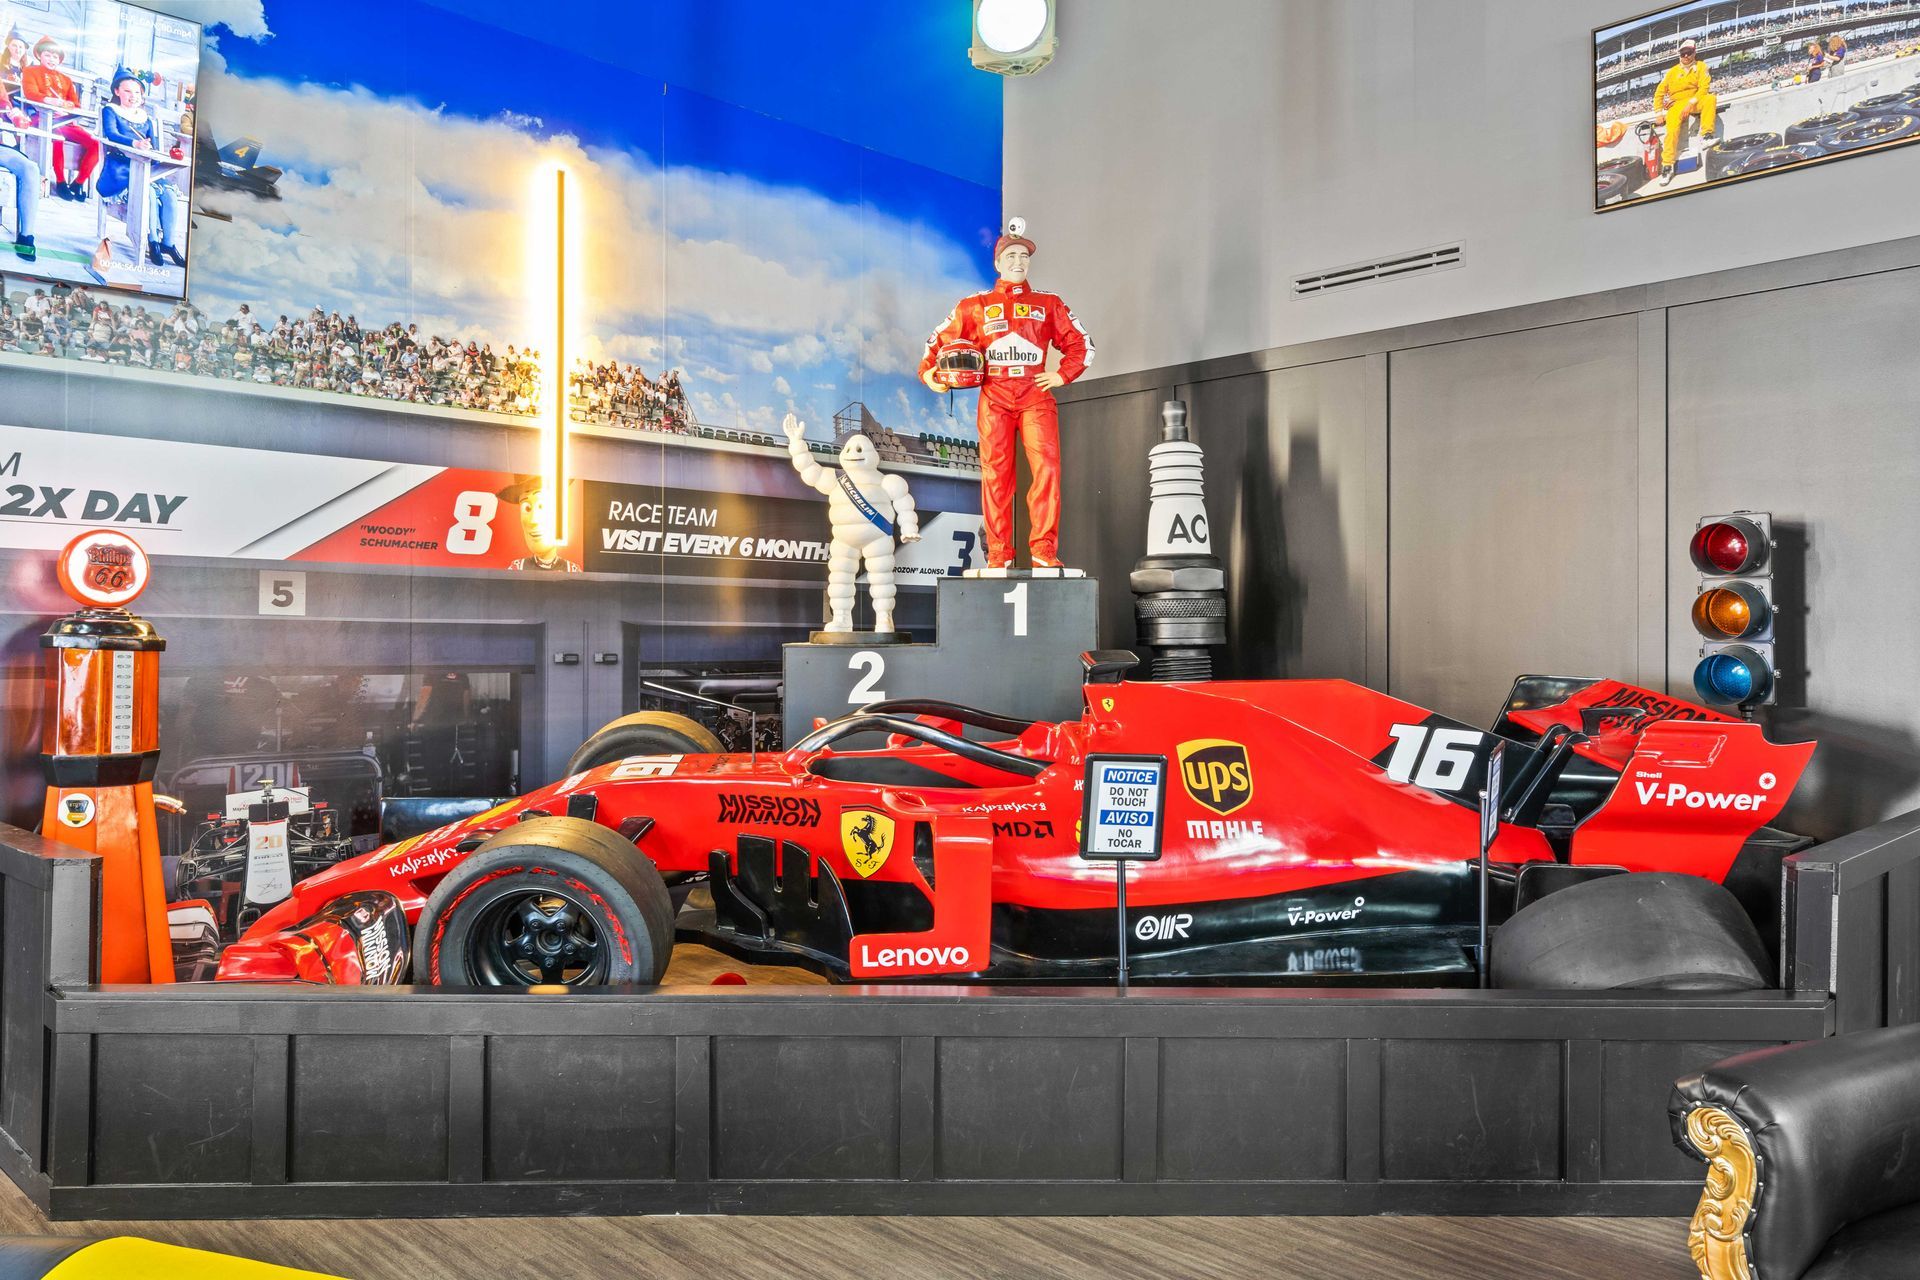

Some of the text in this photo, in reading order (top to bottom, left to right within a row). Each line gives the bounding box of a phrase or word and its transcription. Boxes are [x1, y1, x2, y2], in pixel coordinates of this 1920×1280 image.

[235, 146, 249, 158] 4
[988, 346, 1038, 362] Marlboro
[81, 489, 188, 525] DAY
[845, 481, 875, 516] MICHELIN
[446, 490, 499, 555] 8
[608, 501, 718, 528] RACE TEAM
[360, 524, 416, 536] "WOODY"
[1167, 513, 1207, 544] AC
[360, 538, 438, 550] SCHUMACHER
[602, 528, 832, 561] VISIT EVERY 6 MONTH
[947, 530, 975, 576] 3
[95, 567, 127, 588] 66
[919, 567, 945, 575] ALONSO
[271, 580, 294, 608] 5
[1003, 583, 1027, 636] 1
[848, 651, 885, 704] 2
[1389, 723, 1484, 791] 16
[1107, 770, 1154, 783] NOTICE
[1185, 761, 1248, 802] ups
[1635, 771, 1662, 779] Shell
[1109, 787, 1149, 797] DO NOT
[1111, 797, 1146, 807] TOUCH
[1635, 781, 1767, 811] V-Power
[718, 793, 822, 814] MISSION
[962, 802, 1038, 813] KASPERSKY
[717, 809, 821, 828] WINNOW
[1105, 811, 1149, 824] AVISO
[1118, 829, 1132, 838] NO
[1186, 820, 1263, 838] MAHLE
[1107, 839, 1142, 848] TOCAR
[389, 848, 459, 877] KASPERSKY
[1287, 909, 1362, 927] V-Power
[862, 945, 969, 968] Lenovo
